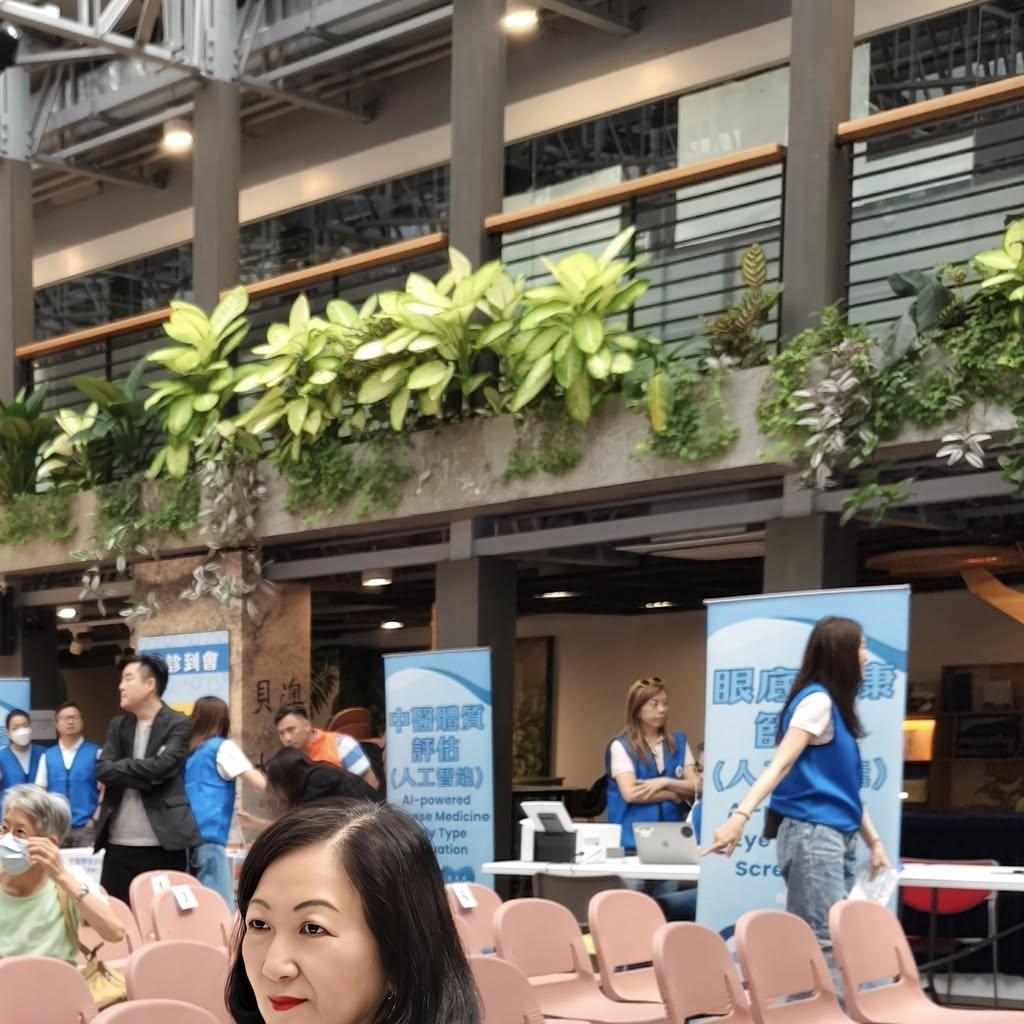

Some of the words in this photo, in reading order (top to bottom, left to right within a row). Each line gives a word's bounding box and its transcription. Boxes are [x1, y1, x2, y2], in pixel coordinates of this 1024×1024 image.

[388, 704, 486, 734] 中醫體質
[411, 736, 461, 764] 評估
[401, 794, 472, 809] AI-powered
[435, 810, 491, 823] Medicine
[438, 827, 468, 843] Type
[735, 860, 786, 877] Scre
